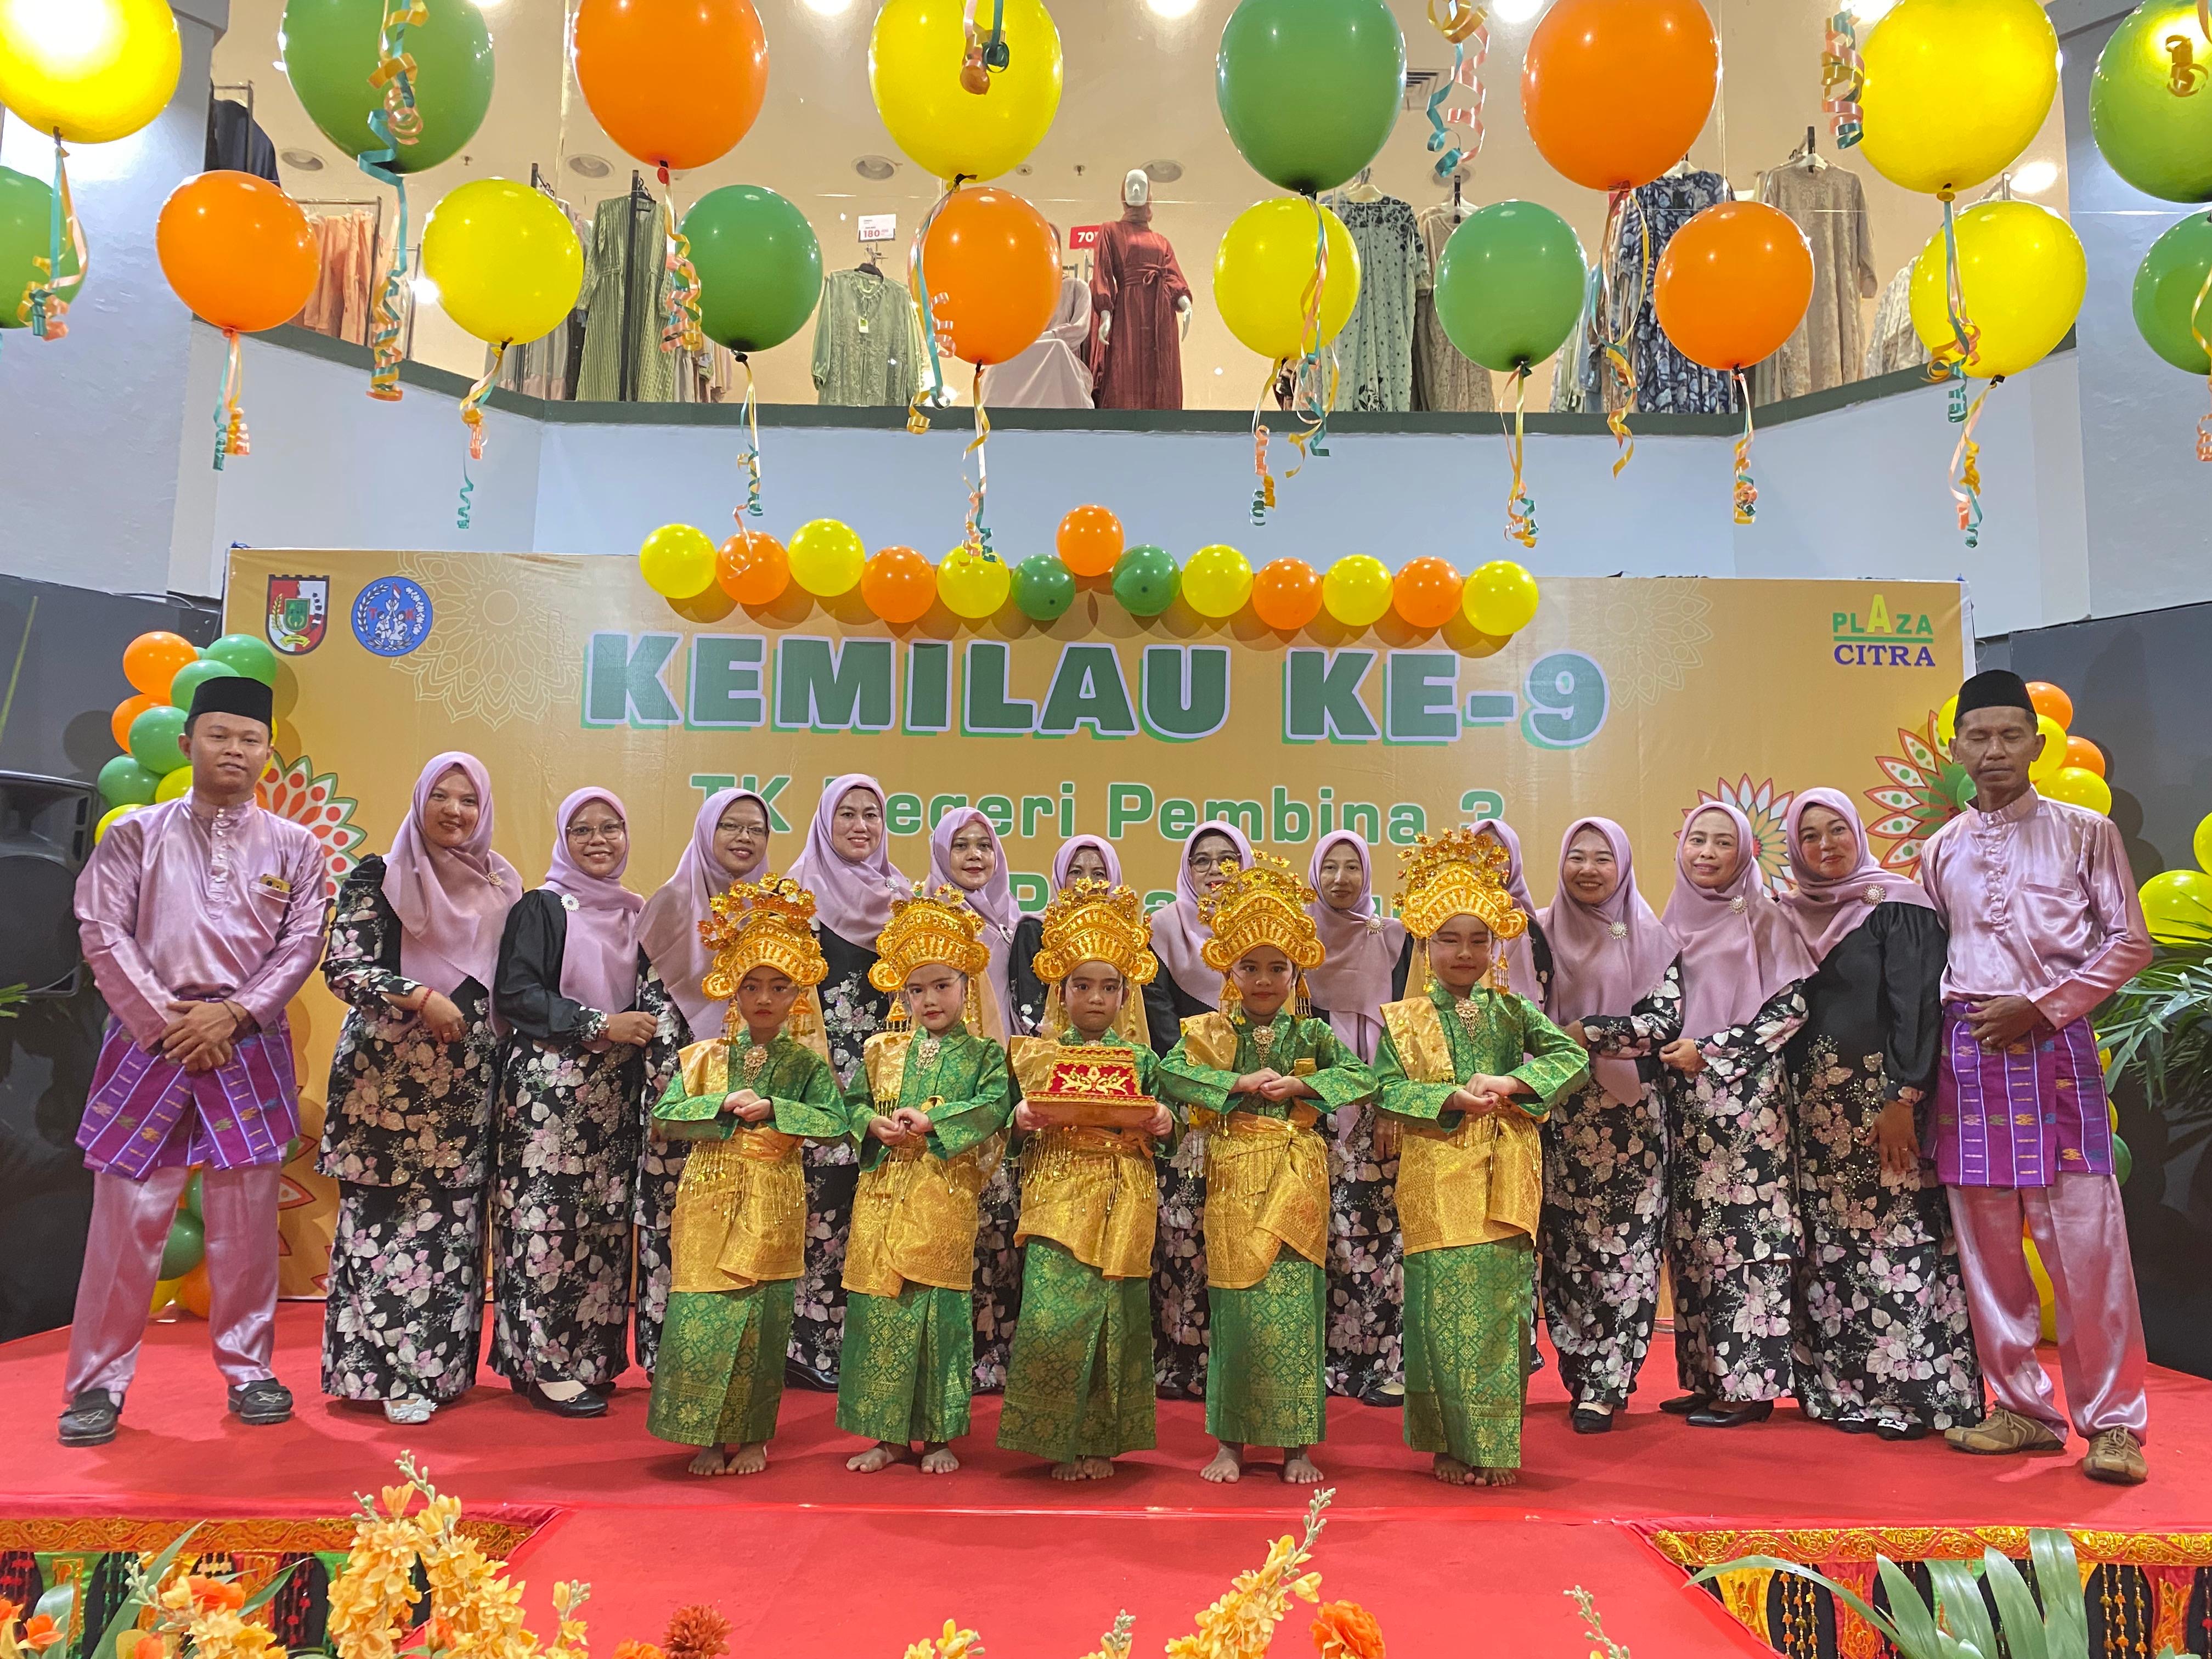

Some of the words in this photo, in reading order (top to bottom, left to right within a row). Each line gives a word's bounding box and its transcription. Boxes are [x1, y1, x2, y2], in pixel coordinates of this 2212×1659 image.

[864, 229, 880, 238] 180
[1077, 231, 1098, 243] 70
[368, 608, 377, 620] T
[1832, 594, 1934, 635] PLAZA
[1833, 644, 1936, 667] CITRA
[580, 631, 1232, 743] KEMILAU
[1282, 647, 1610, 751] KE-9
[690, 774, 792, 833] TK
[824, 778, 1076, 845] eeri
[1107, 782, 1426, 846] Pembina
